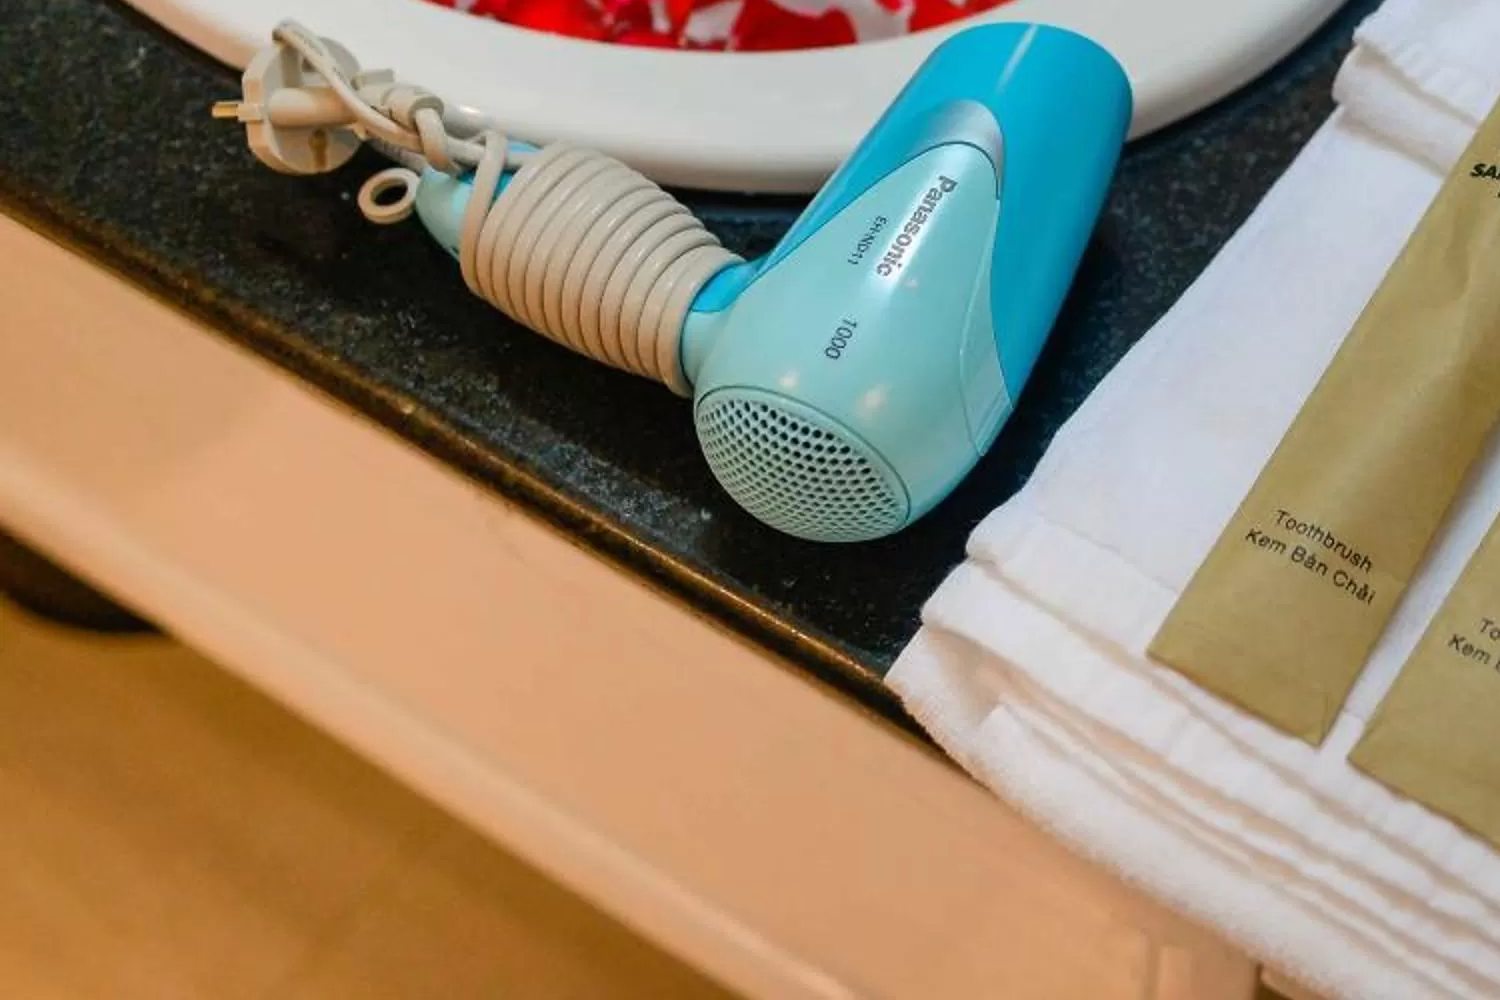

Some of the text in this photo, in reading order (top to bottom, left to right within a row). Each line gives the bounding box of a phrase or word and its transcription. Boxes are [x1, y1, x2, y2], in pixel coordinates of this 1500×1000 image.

[876, 174, 959, 278] Panasonic
[824, 317, 858, 361] 1000
[1244, 527, 1288, 555] Kem
[1275, 508, 1374, 575] Toothbrush
[1447, 633, 1492, 665] Kem
